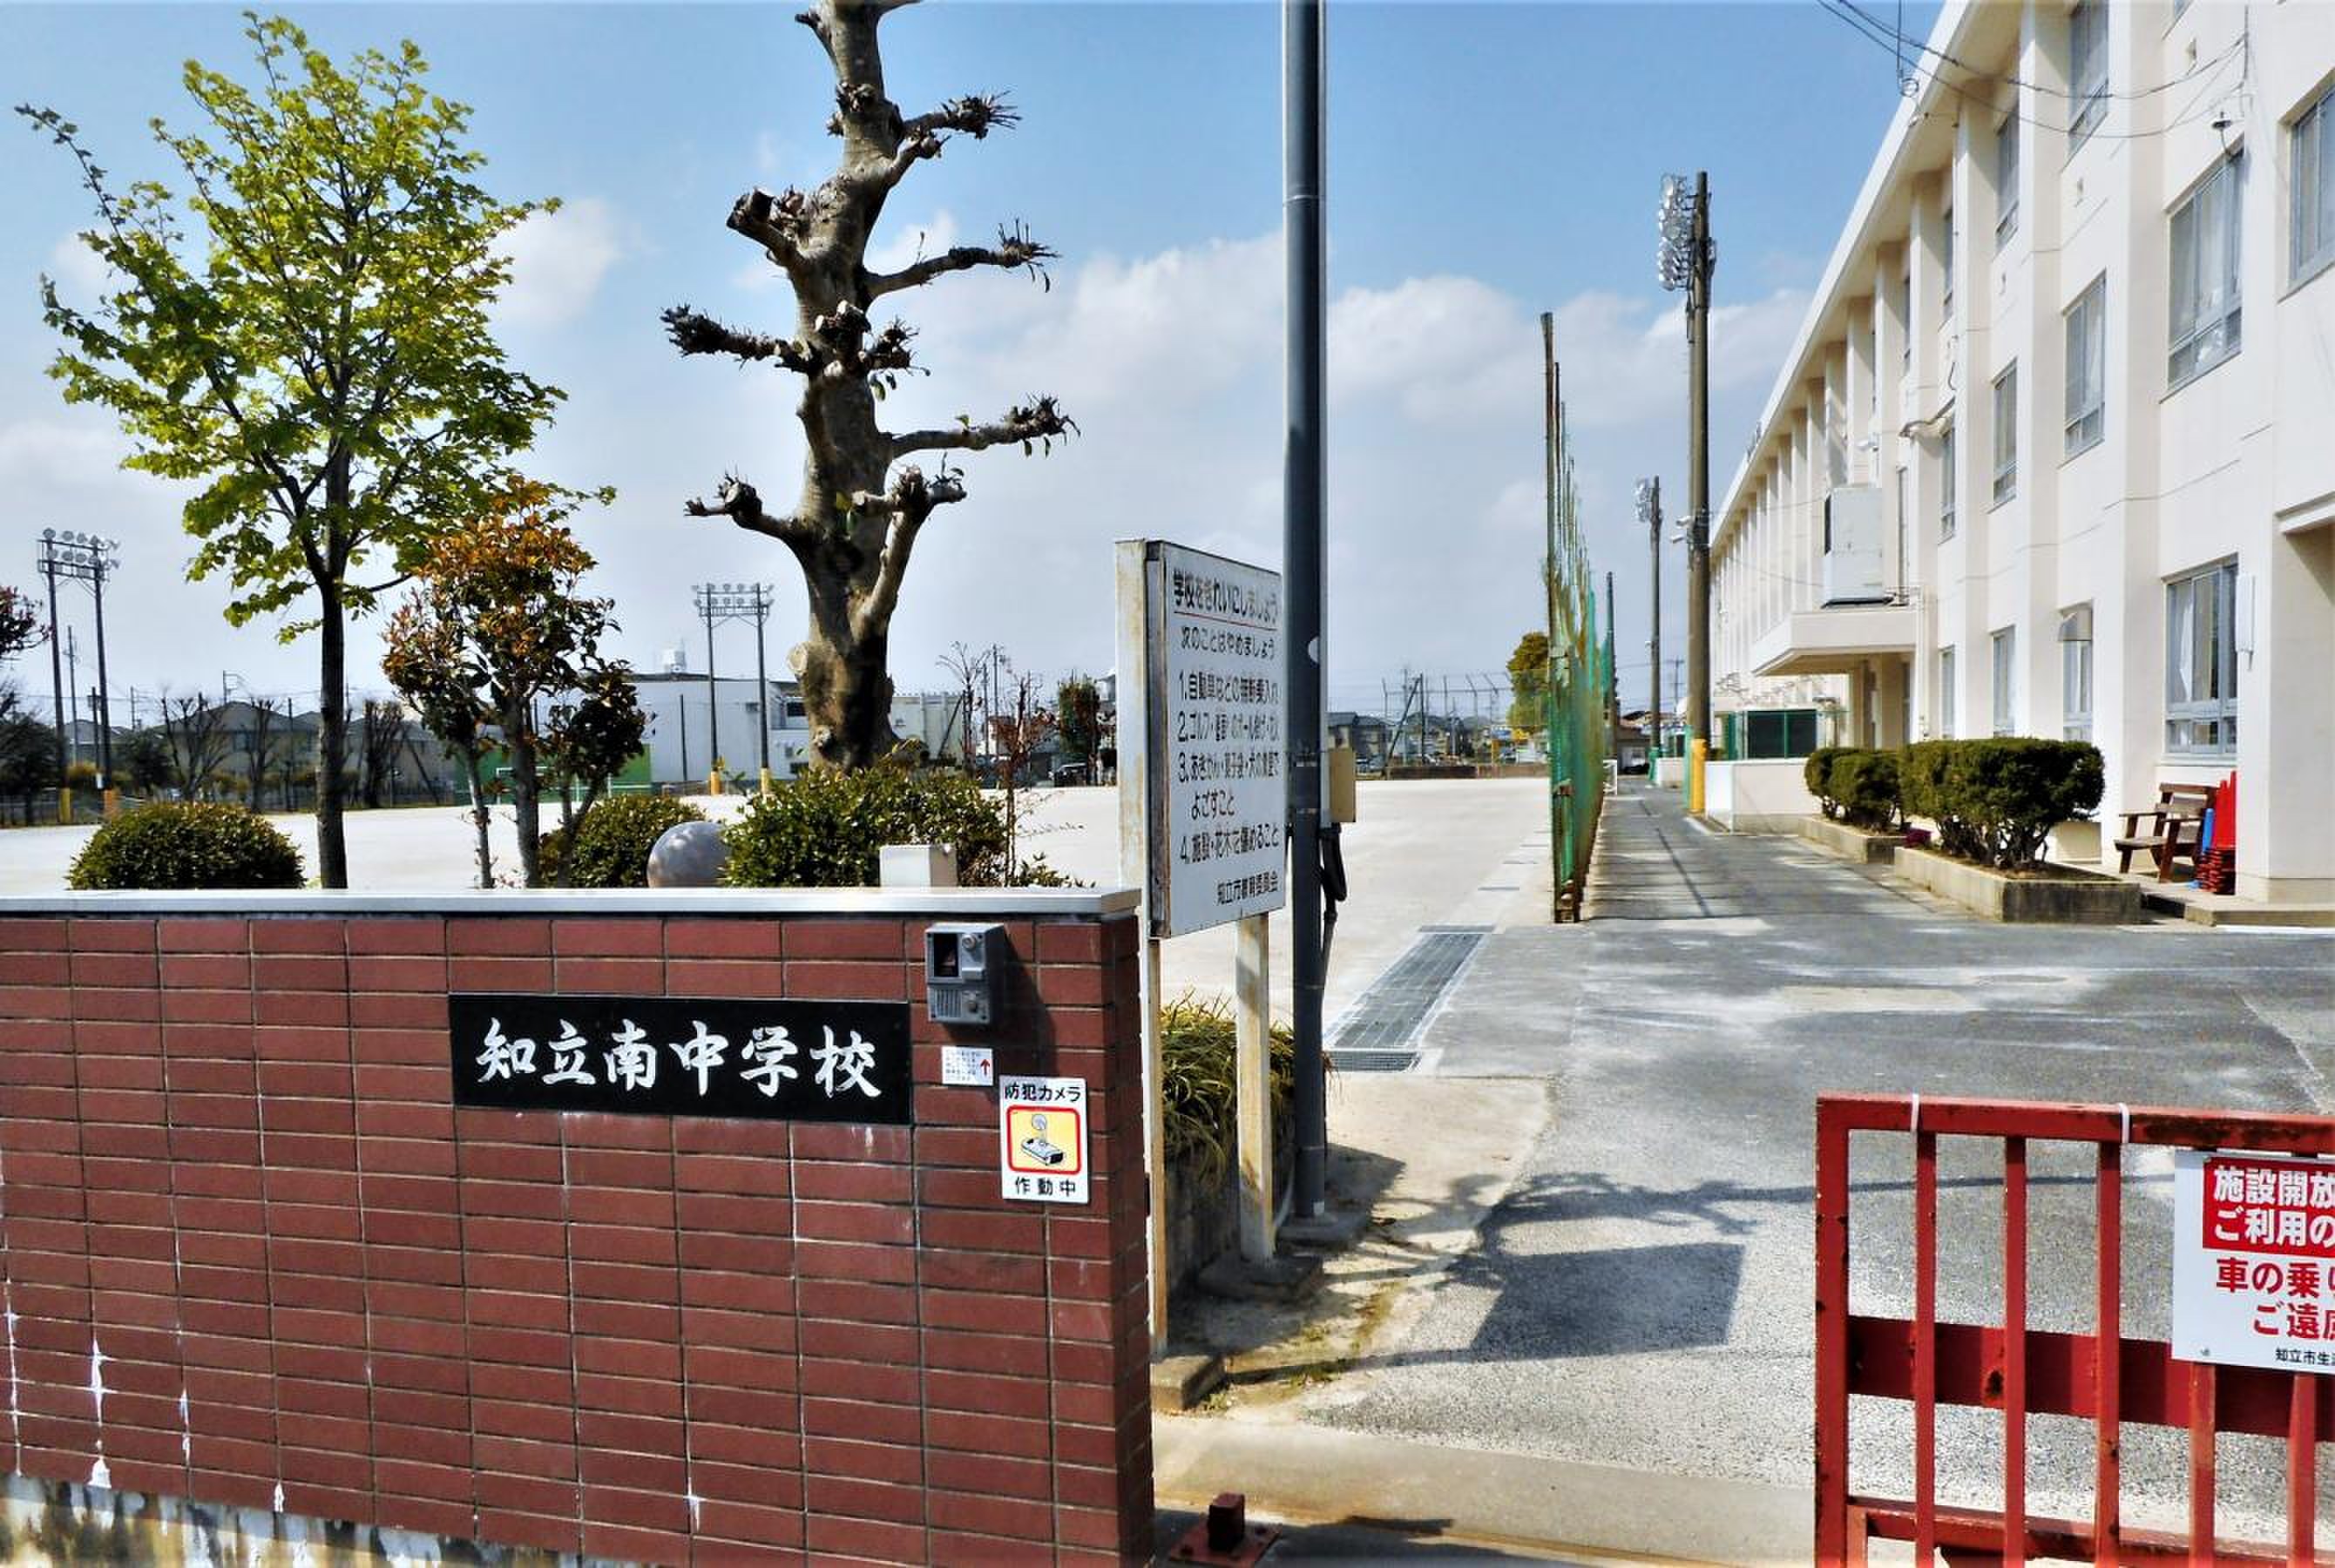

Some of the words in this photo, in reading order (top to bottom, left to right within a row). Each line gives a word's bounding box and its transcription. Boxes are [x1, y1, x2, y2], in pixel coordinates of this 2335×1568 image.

[1181, 626, 1275, 660] 次のことはやめましょう
[1191, 789, 1235, 820] よごすこと
[477, 1017, 882, 1099] 知立南中学校
[1004, 1082, 1081, 1103] 防犯カメラ
[1015, 1176, 1076, 1197] 作動中
[2213, 1164, 2335, 1209] 施設開放
[2215, 1205, 2335, 1248] ご利用の
[2275, 1347, 2335, 1366] 知立市生
